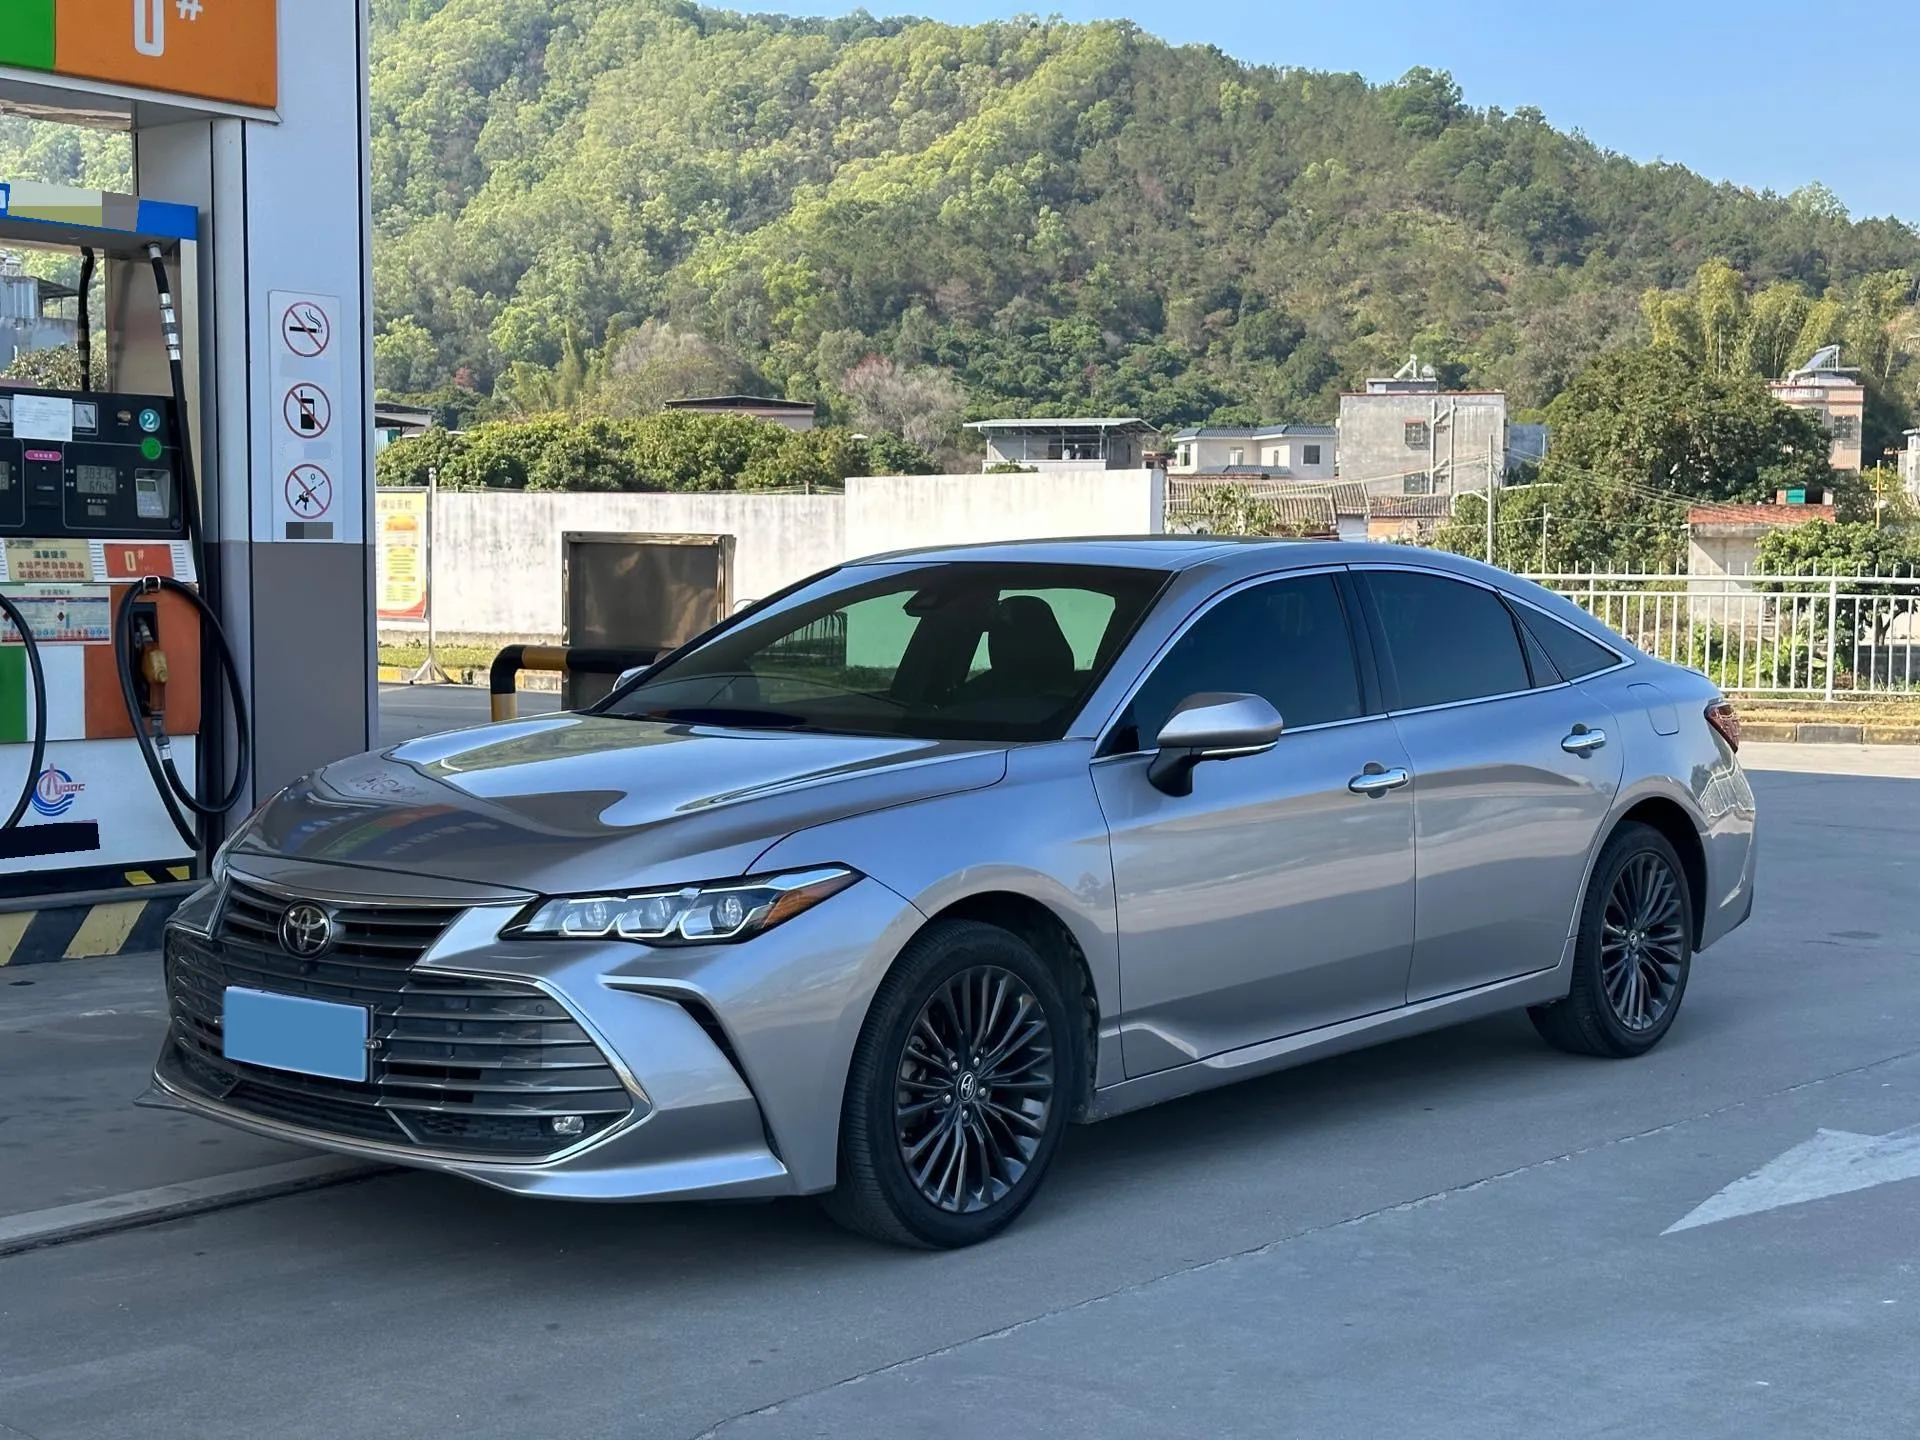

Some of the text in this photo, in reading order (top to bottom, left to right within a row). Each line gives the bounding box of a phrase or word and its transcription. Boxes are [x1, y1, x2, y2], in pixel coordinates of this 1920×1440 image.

[144, 412, 156, 429] 2
[34, 550, 67, 559] 温馨提示
[17, 561, 84, 570] 本站严禁自助加油
